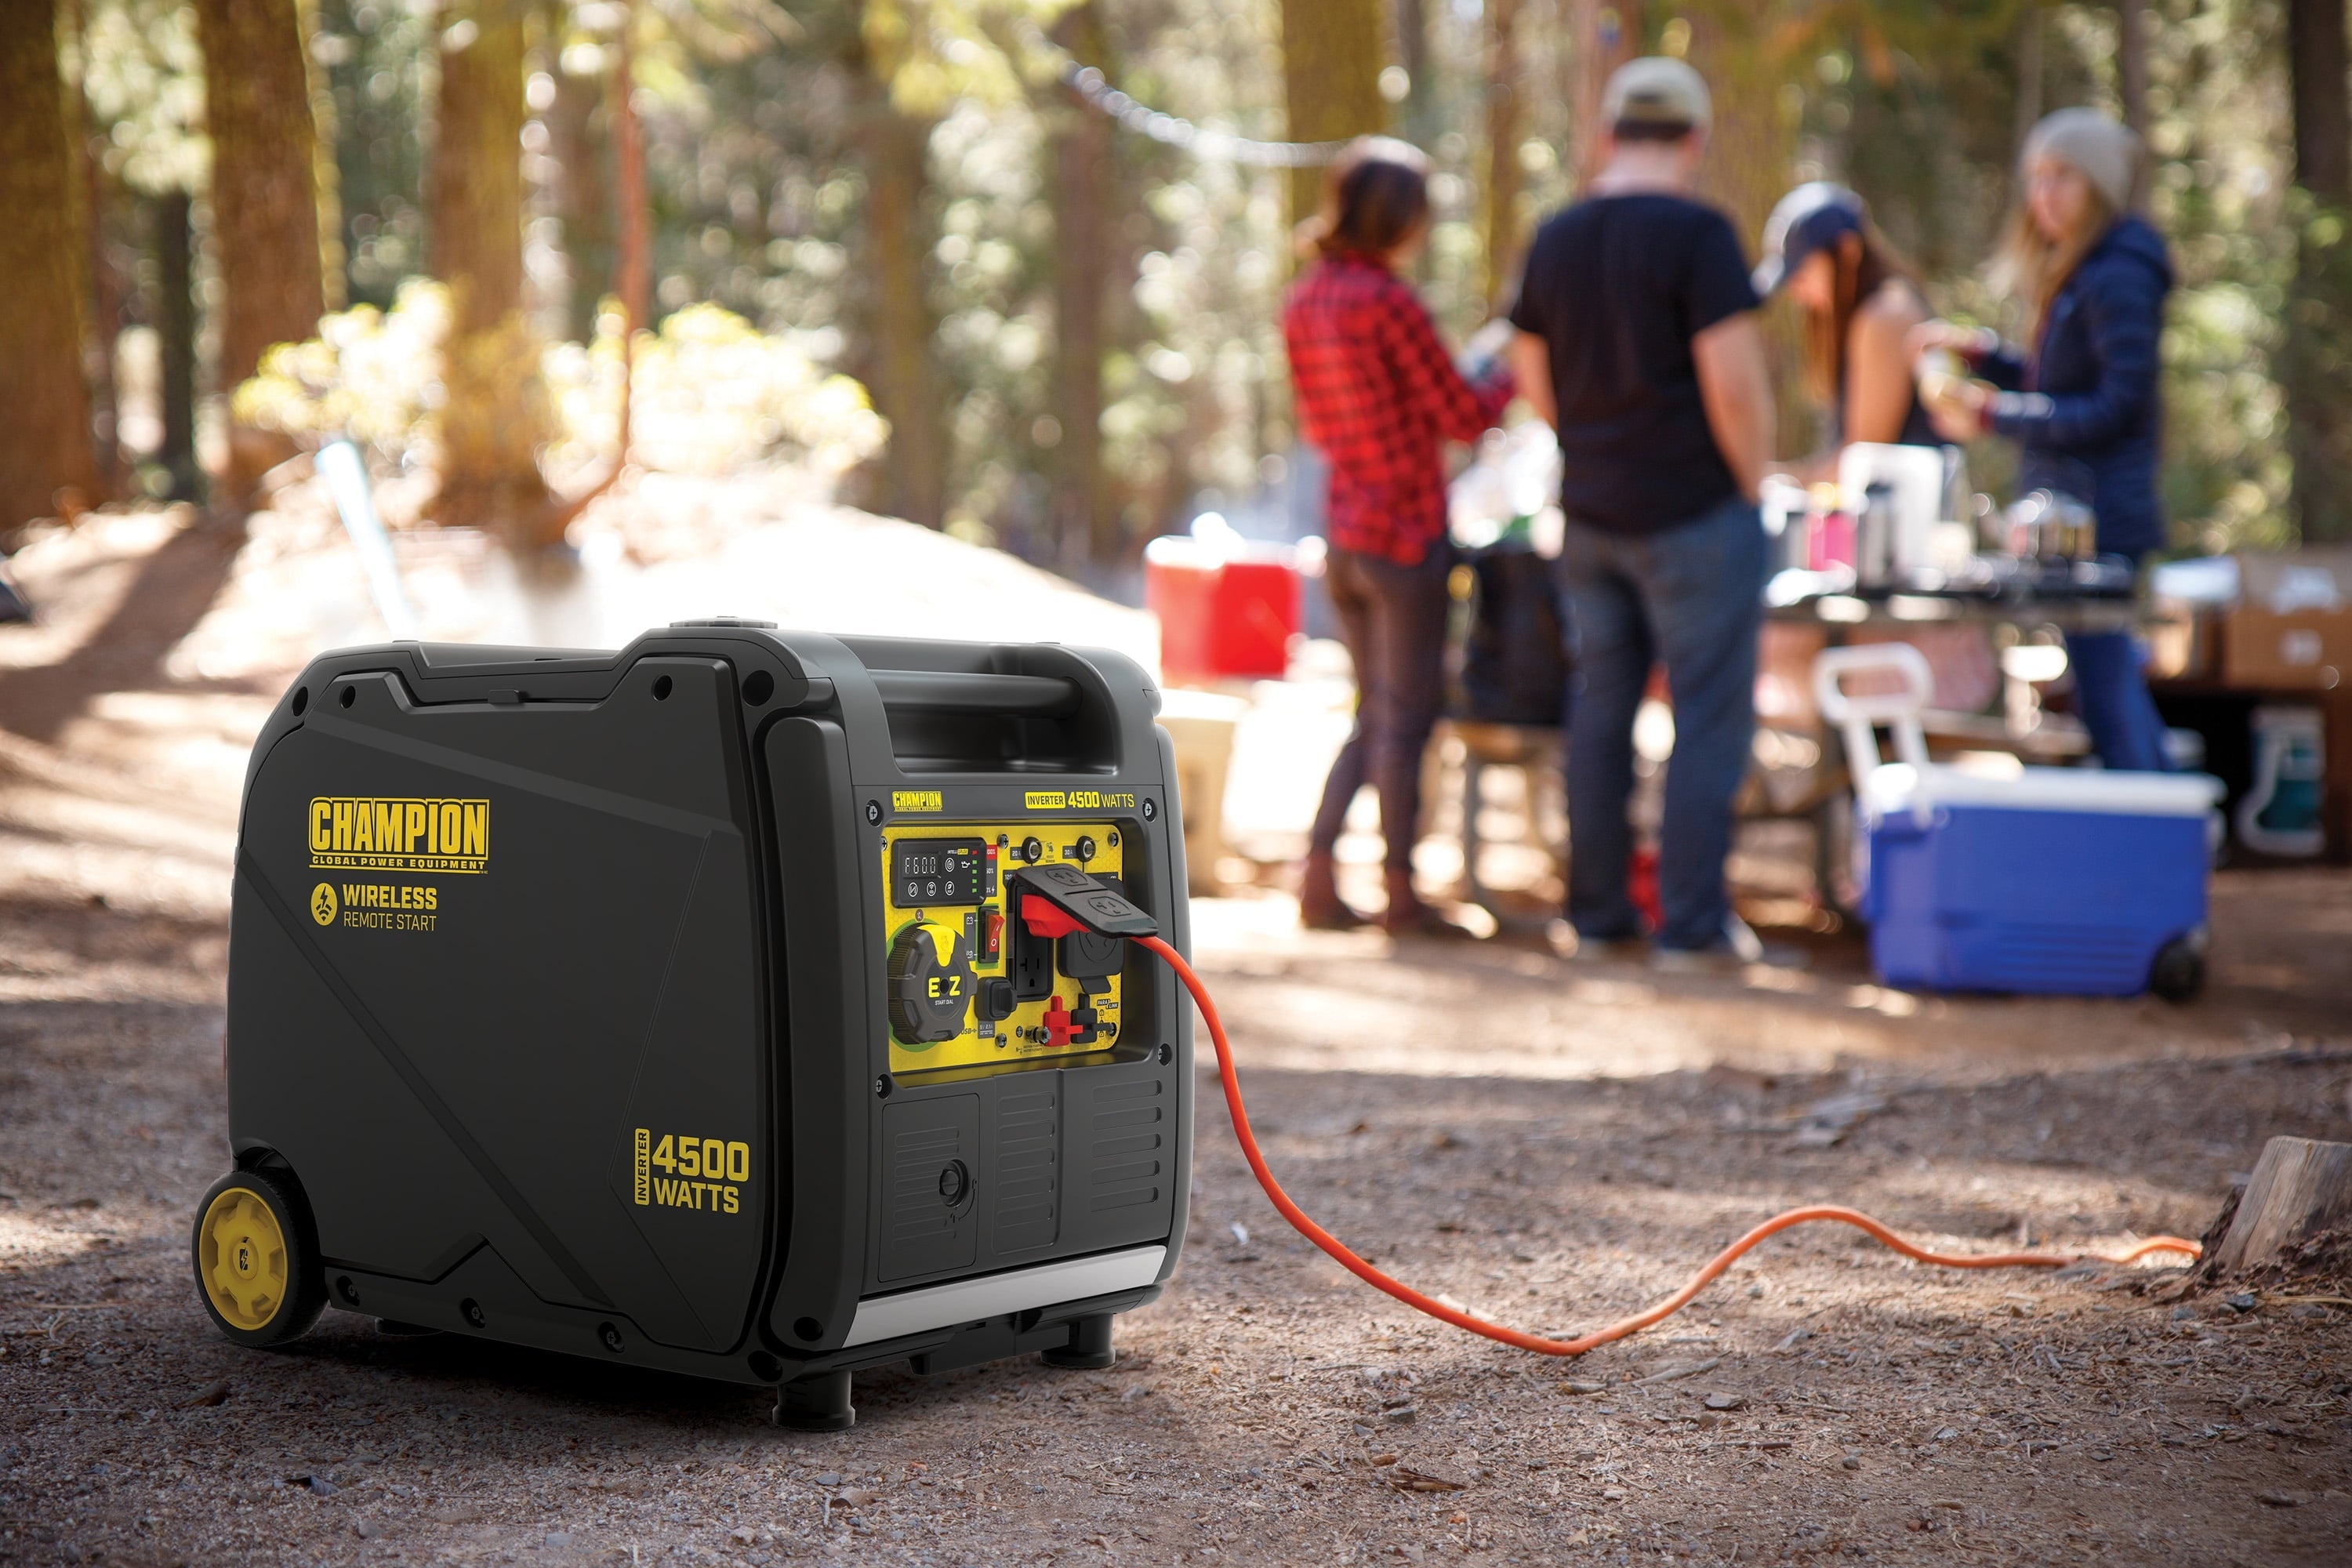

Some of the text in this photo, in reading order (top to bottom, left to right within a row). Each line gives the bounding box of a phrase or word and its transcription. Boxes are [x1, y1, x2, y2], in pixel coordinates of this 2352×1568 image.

[894, 793, 942, 807] CHAMPION
[1027, 791, 1134, 808] INVERTER 4500 WATTS
[311, 802, 486, 855] CHAMPION
[312, 855, 485, 869] GLOBAL POWER EQUIPMENT
[343, 884, 437, 910] WIRELESS
[343, 912, 437, 931] REMOTE START
[637, 1131, 648, 1201] INVERTER
[652, 1134, 750, 1182] 4500
[653, 1178, 739, 1214] WATTS
